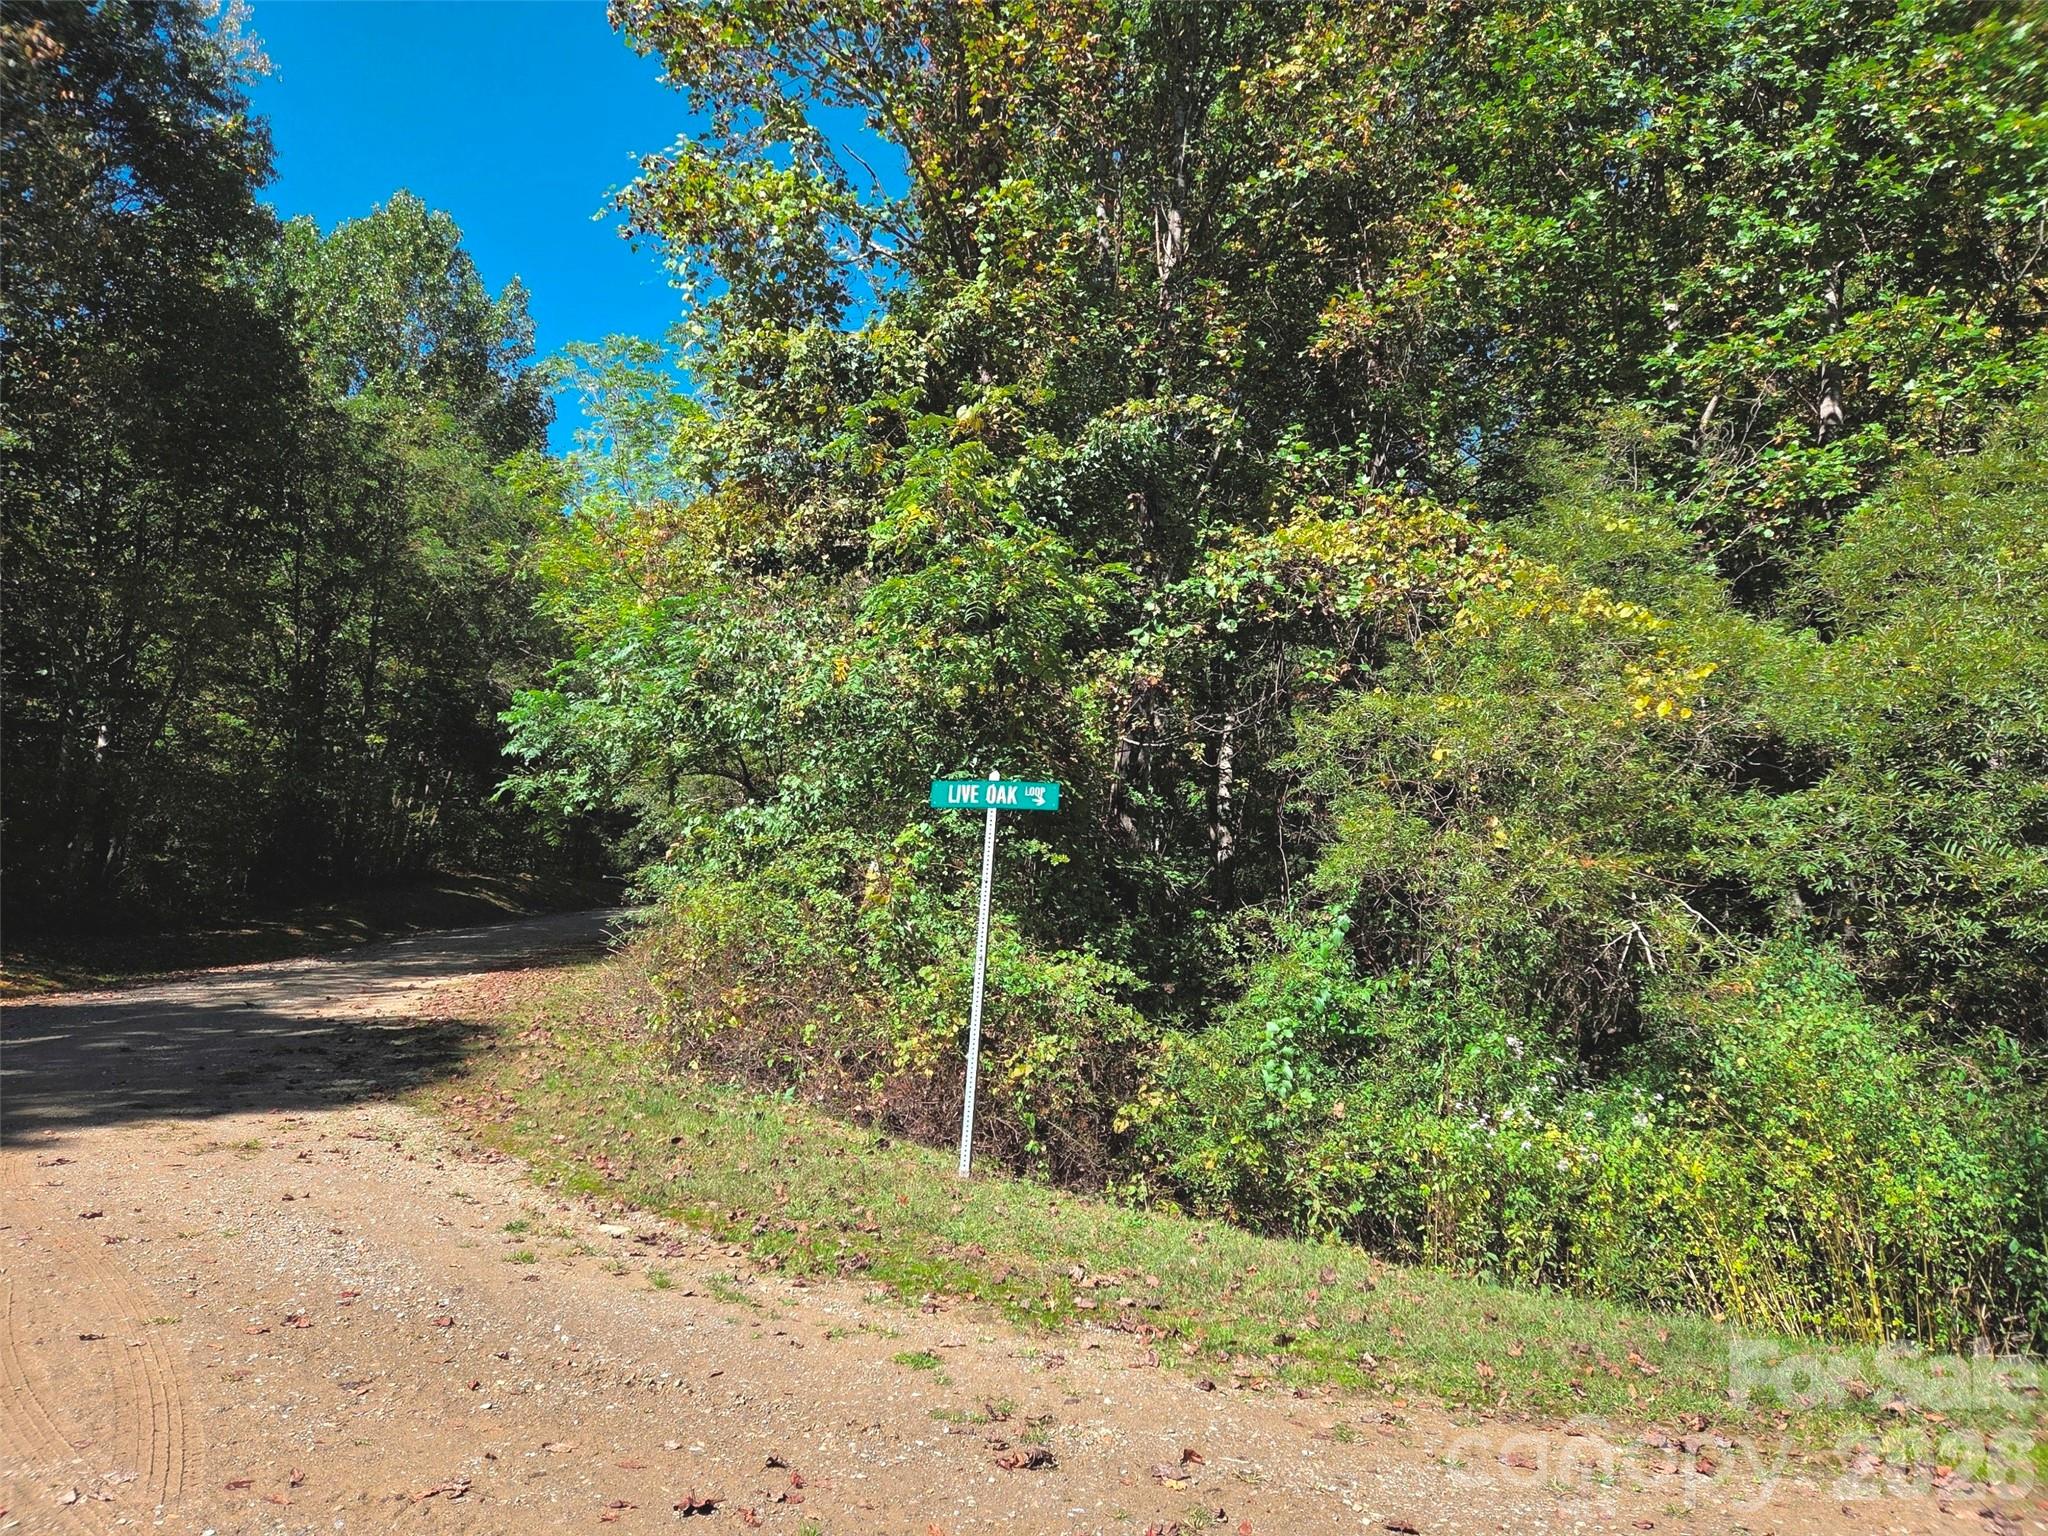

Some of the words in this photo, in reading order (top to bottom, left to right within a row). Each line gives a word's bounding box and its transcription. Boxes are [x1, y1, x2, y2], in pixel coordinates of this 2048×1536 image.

[948, 784, 979, 804] LIVE
[986, 784, 1018, 805] OAK
[1025, 786, 1046, 797] LOOP
